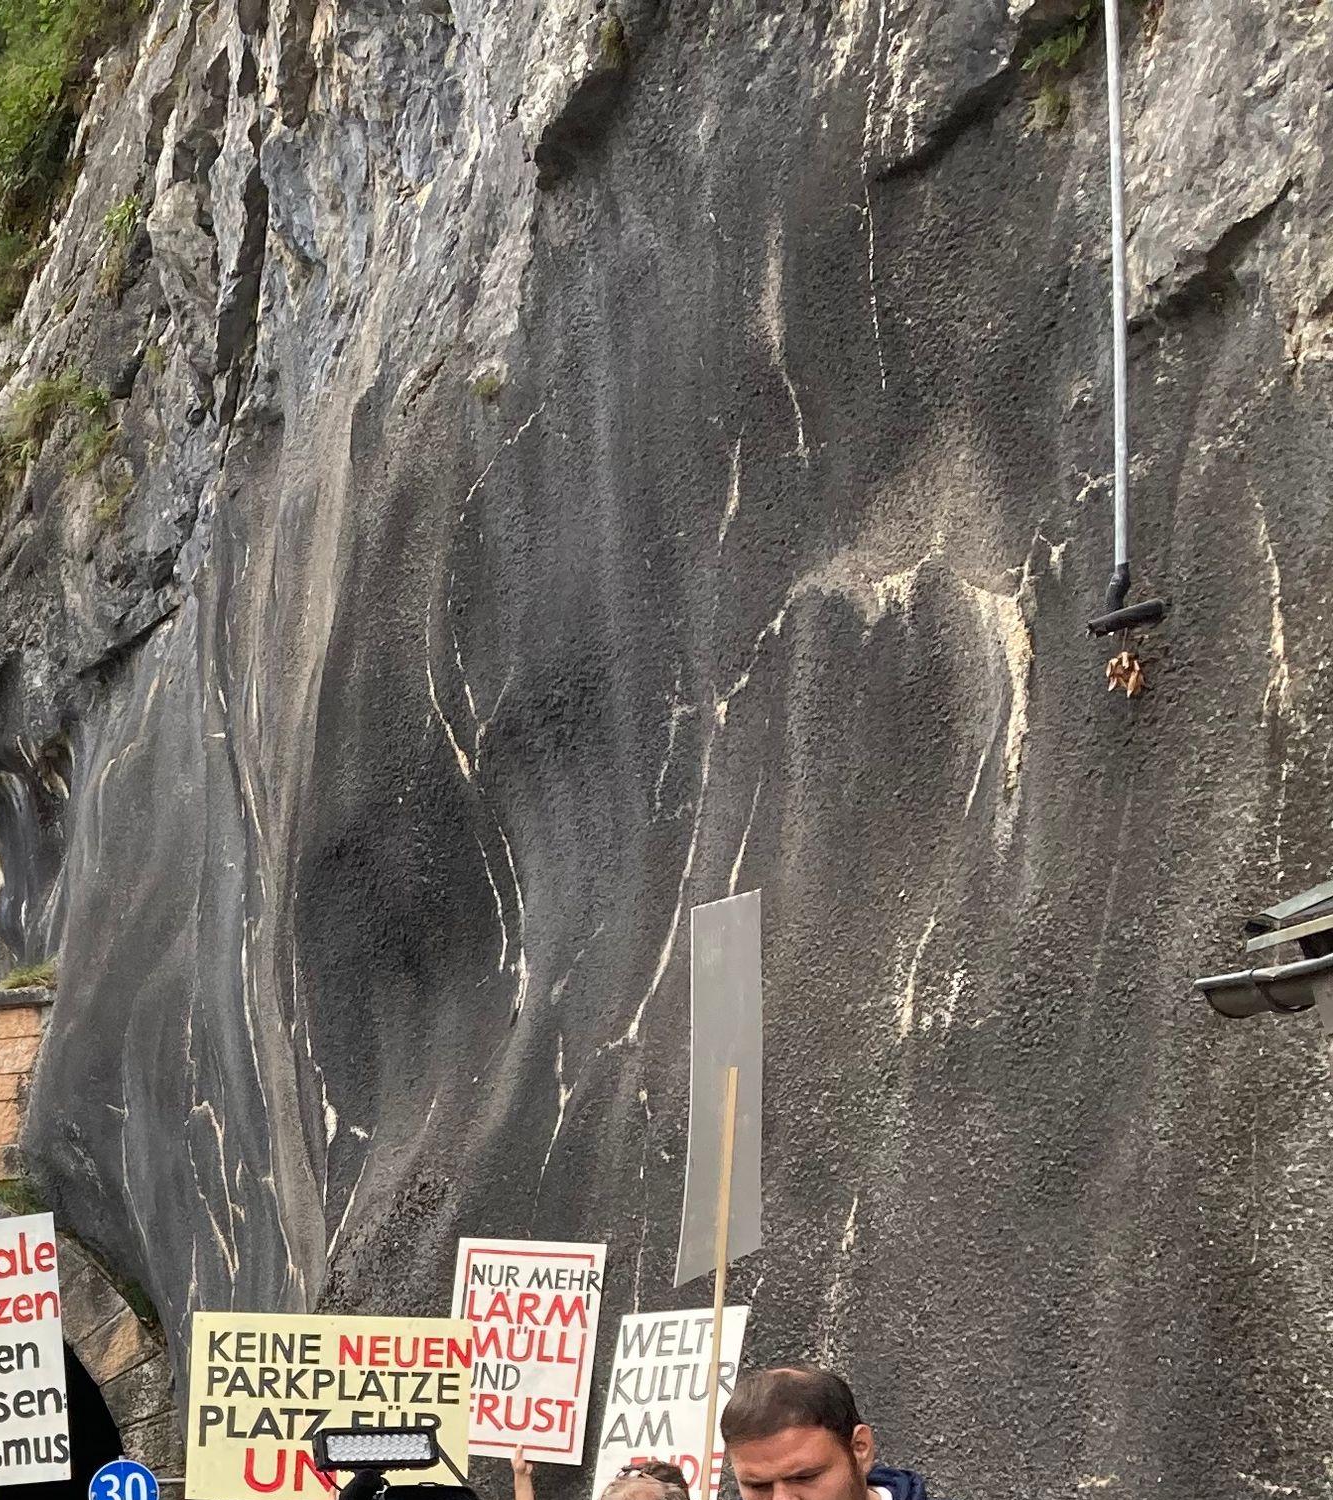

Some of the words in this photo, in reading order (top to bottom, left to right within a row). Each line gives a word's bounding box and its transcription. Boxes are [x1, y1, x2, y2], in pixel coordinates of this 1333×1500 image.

[470, 1263, 520, 1288] NUR
[526, 1267, 602, 1292] MEHR
[467, 1289, 588, 1329] LÄRM
[208, 1331, 321, 1364] KEINE
[339, 1335, 473, 1369] NEUEN
[473, 1326, 577, 1364] MÜLL
[207, 1366, 460, 1404] PARKPLÄTZE
[612, 1361, 736, 1405] KULTUR
[199, 1405, 332, 1446] PLATZ
[602, 1410, 674, 1449] AM
